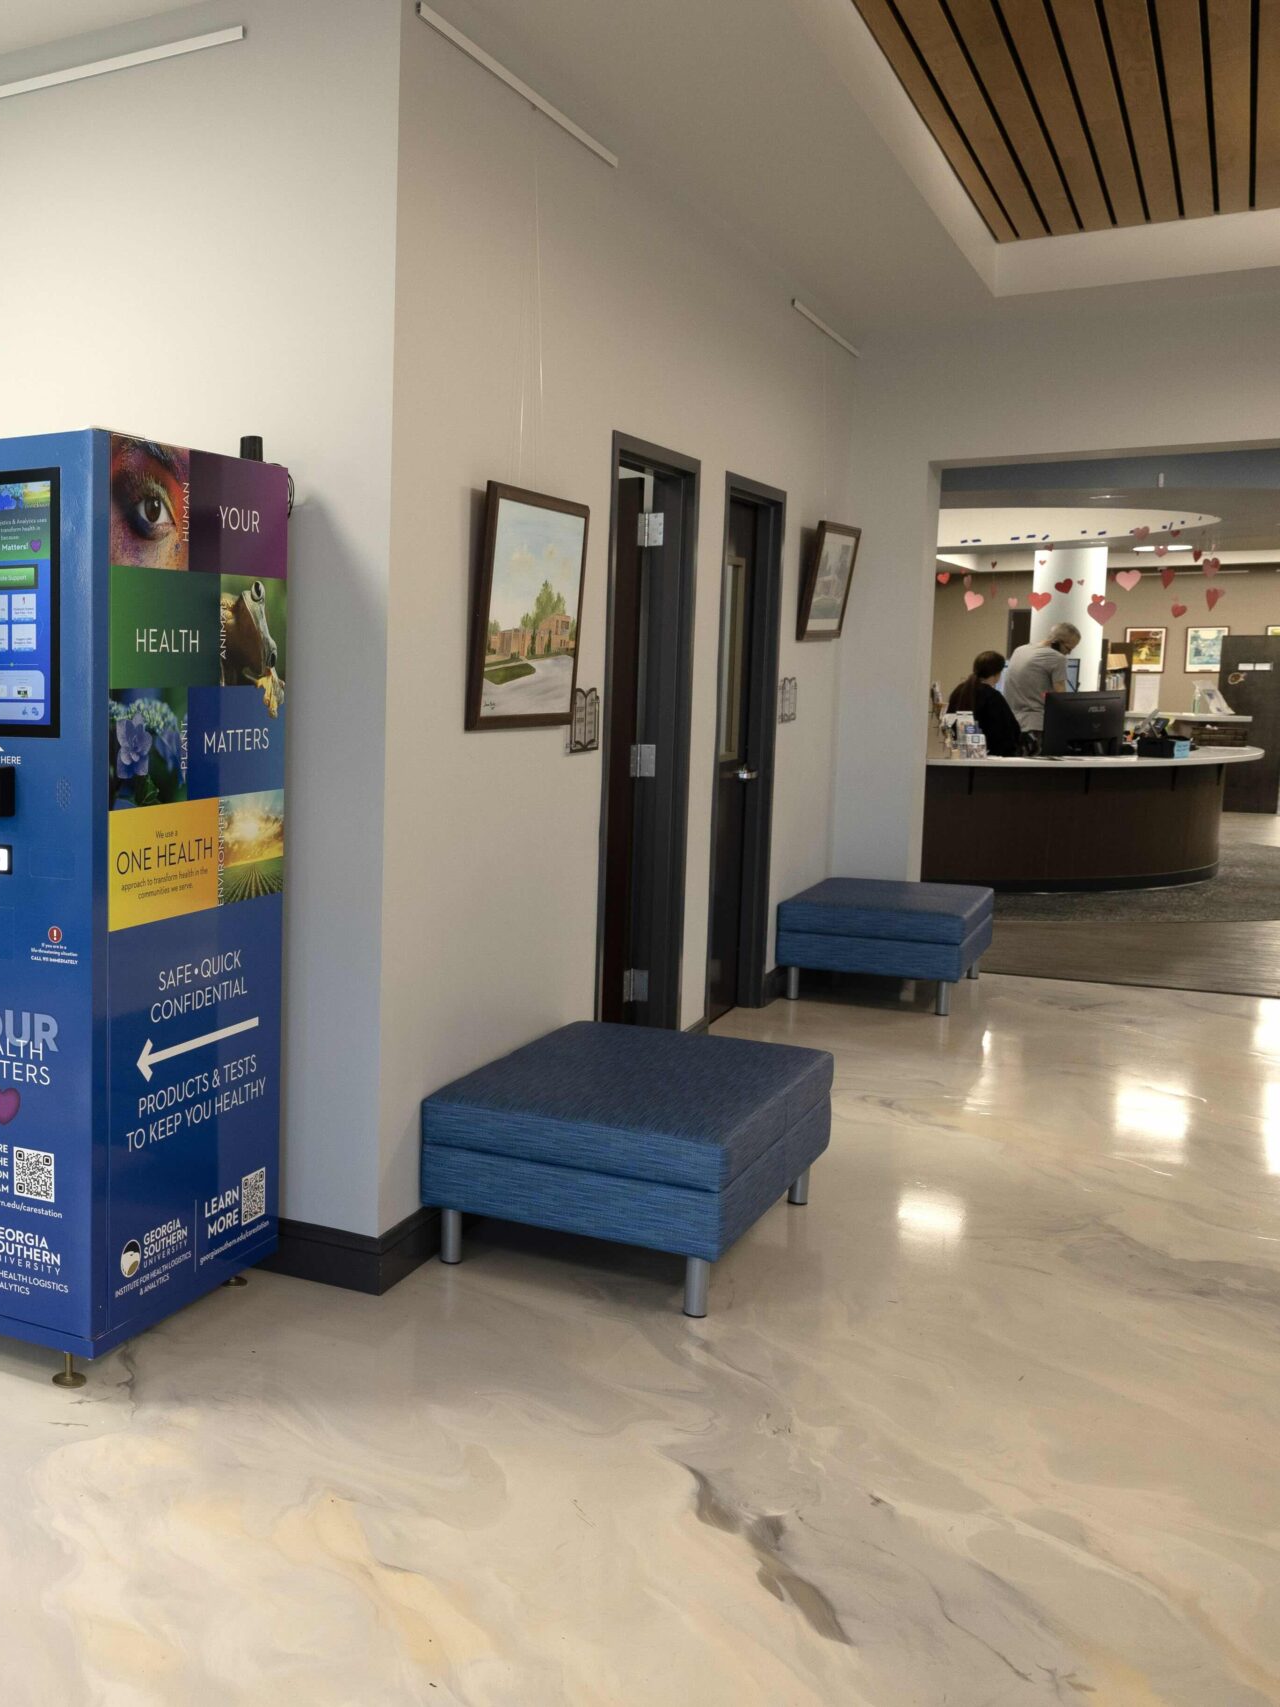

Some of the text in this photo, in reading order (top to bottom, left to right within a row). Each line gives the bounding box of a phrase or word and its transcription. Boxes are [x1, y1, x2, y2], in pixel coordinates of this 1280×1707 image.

[182, 482, 190, 543] HUMAN
[219, 505, 260, 533] YOUR
[2, 542, 29, 551] Matters!
[136, 628, 200, 653] HEALTH
[204, 727, 270, 754] MATTERS
[0, 756, 21, 765] HERE
[156, 830, 164, 838] We
[116, 836, 213, 875] ONE HEALTH
[121, 878, 146, 892] approach
[154, 873, 178, 884] transform
[178, 868, 194, 880] health
[138, 885, 170, 900] communities
[158, 963, 192, 991] SAFE
[200, 950, 242, 979] QUICK
[150, 976, 248, 1024] CONFIDENTIAL
[138, 1054, 257, 1119] PRODUCTS & TESTS
[126, 1076, 267, 1153] TO KEEP YOU HEALTHY
[204, 1185, 240, 1218] LEARN
[144, 1218, 181, 1246] GEORGIA
[208, 1208, 239, 1239] MORE
[144, 1226, 188, 1260] SOUTHERN
[144, 1238, 188, 1269] UNIVERSITY
[28, 1277, 69, 1294] LOGISTICS
[115, 1250, 192, 1299] INSTITUTE FOR HEALTH LOGISTICS
[144, 1272, 170, 1293] ANALYTICS
